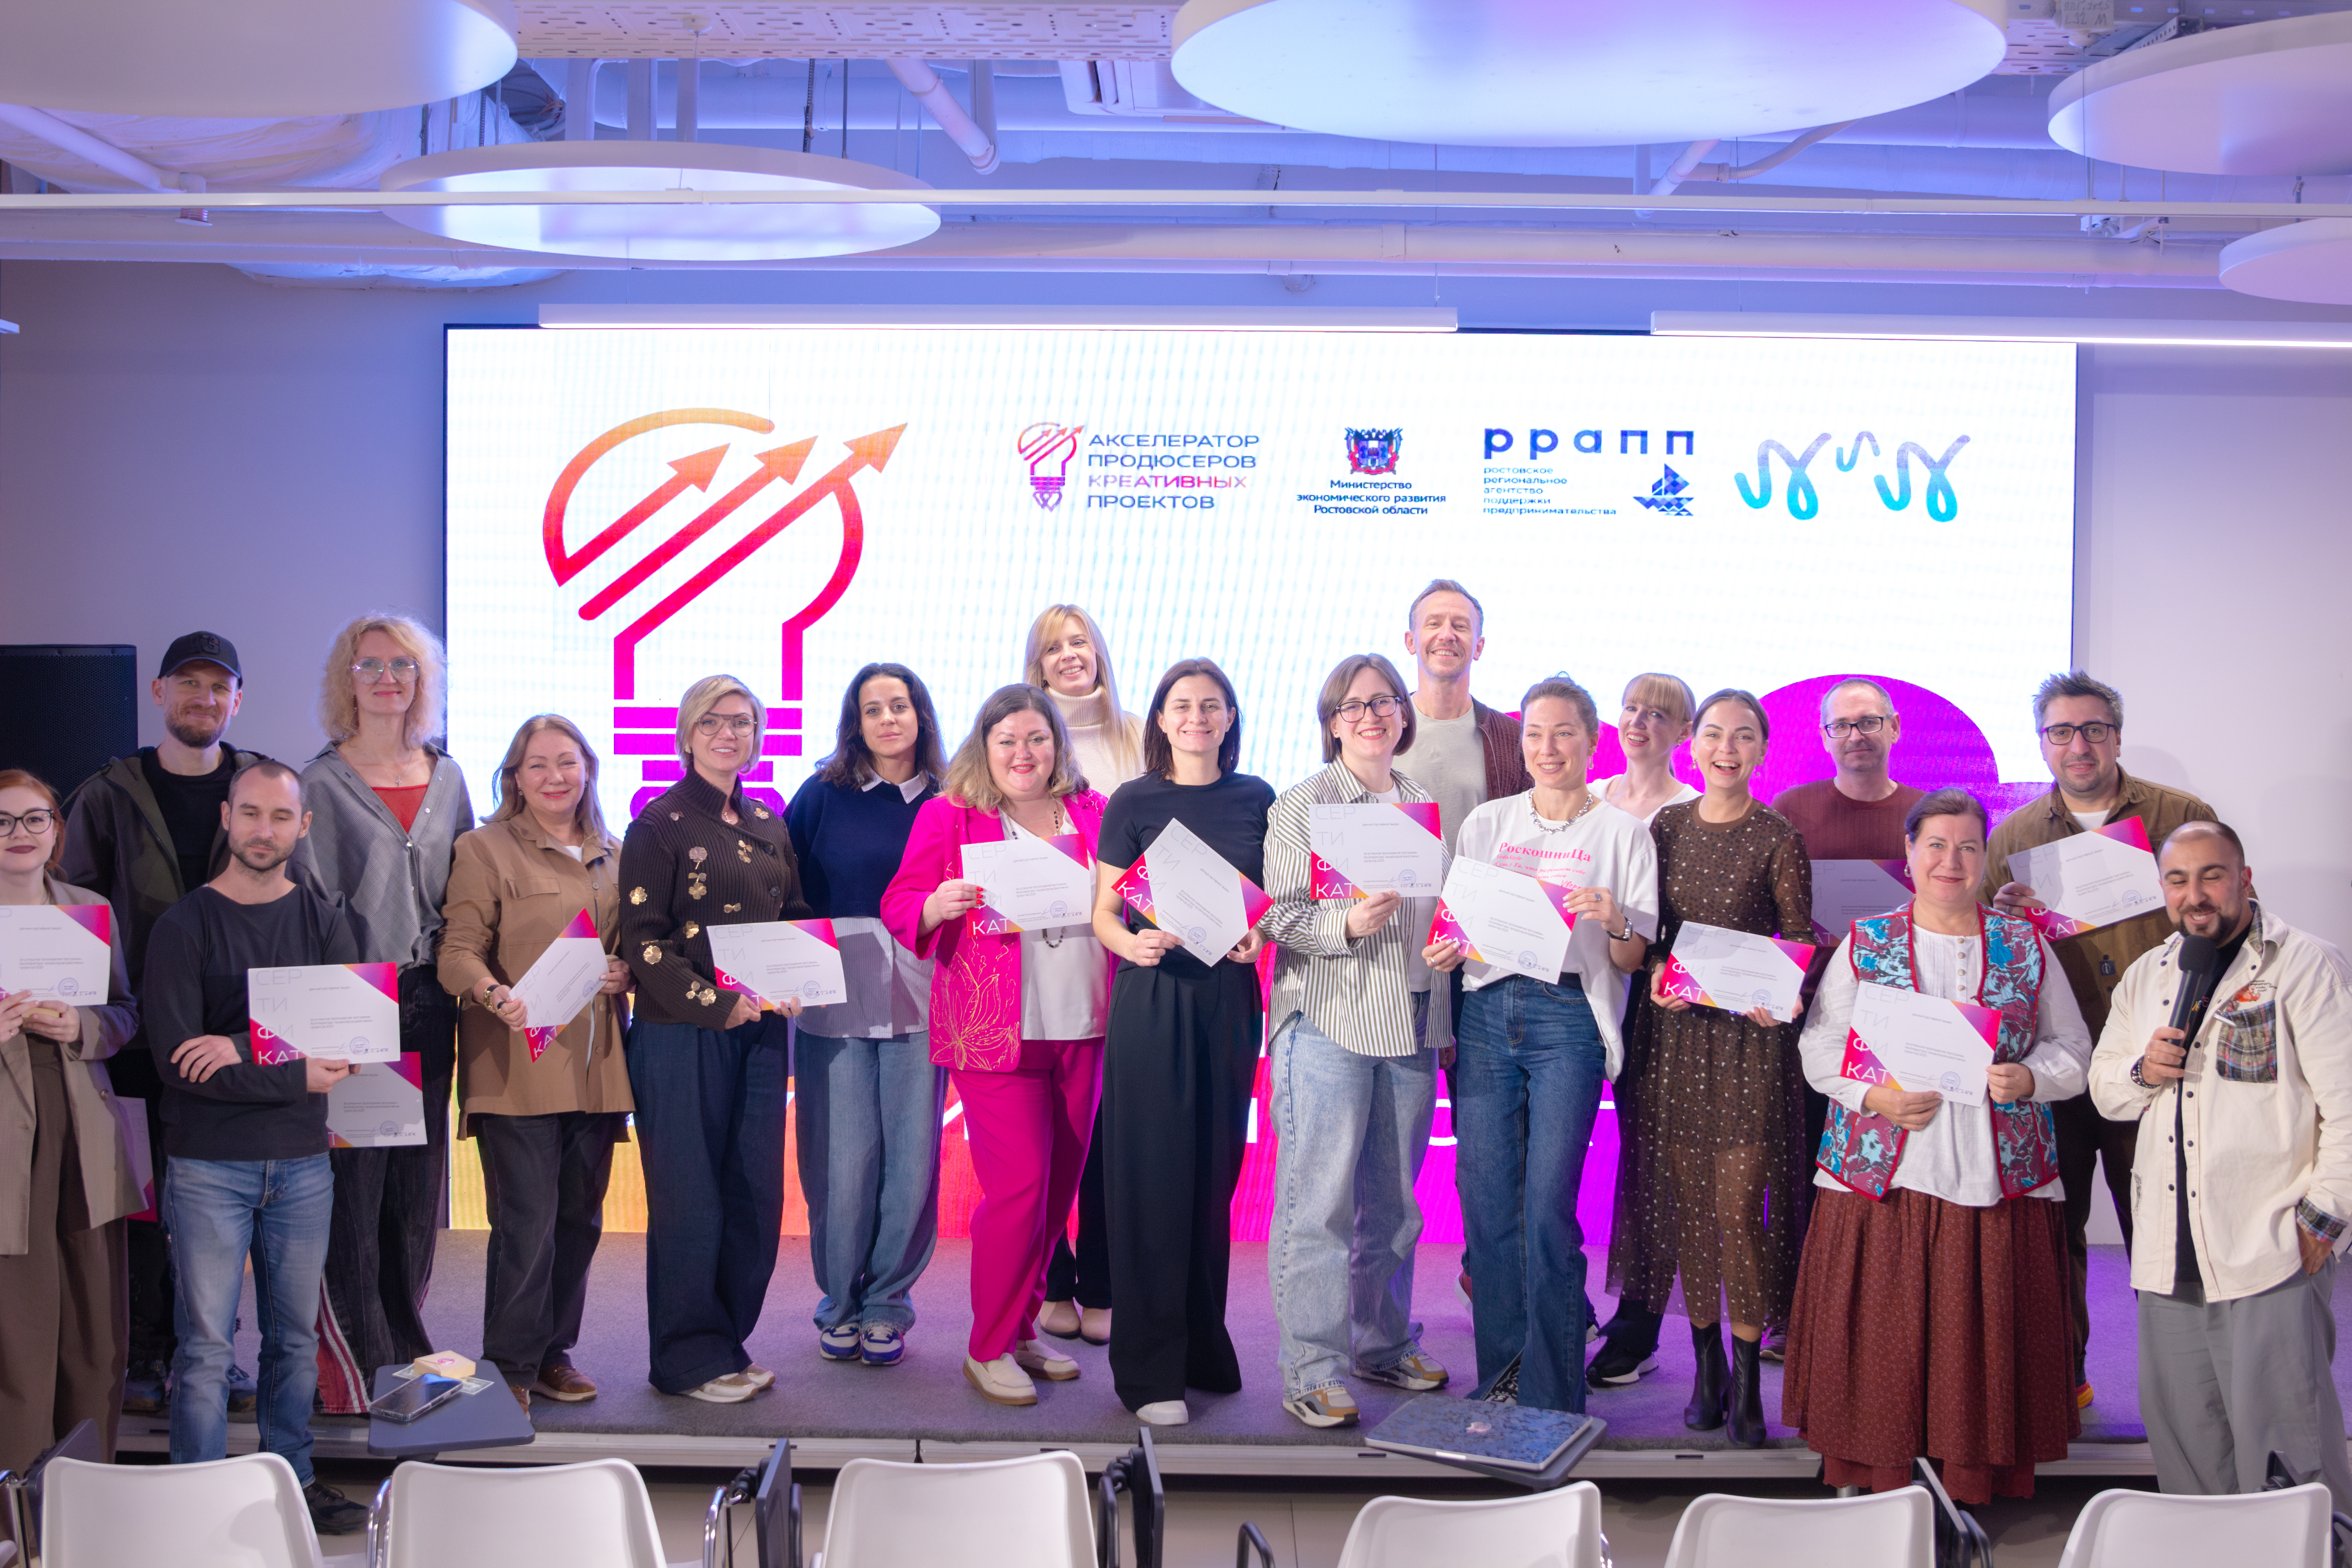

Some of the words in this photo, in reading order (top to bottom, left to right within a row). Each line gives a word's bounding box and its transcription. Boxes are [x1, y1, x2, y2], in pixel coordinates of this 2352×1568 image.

[1088, 434, 1259, 448] АКСЕЛЕРАТОР
[1088, 454, 1256, 470] ПРОДЮСЕРОВ
[1088, 475, 1247, 489] КРЕАТИВНЫХ
[1330, 480, 1412, 490] Министерство
[1088, 495, 1215, 509] ПРОЕКТОВ
[1296, 494, 1390, 503] экономического
[1394, 495, 1446, 504] развития
[1314, 504, 1379, 514] Ростовской
[1382, 505, 1428, 514] области
[1315, 806, 1356, 820] СЕР
[1316, 831, 1344, 846] ТИ
[968, 843, 1006, 860] СЕР
[1499, 842, 1591, 862] РоскошниЦа
[1812, 862, 1835, 875] ЕР
[1117, 881, 1156, 912] КАТ
[1316, 882, 1357, 897] КАТ
[972, 917, 1011, 935] КАТ
[1814, 932, 1832, 945] АТ
[255, 969, 302, 985] СЕР
[1664, 981, 1706, 1002] КАТ
[258, 1050, 302, 1064] КАТ
[1846, 1061, 1892, 1084] КАТ
